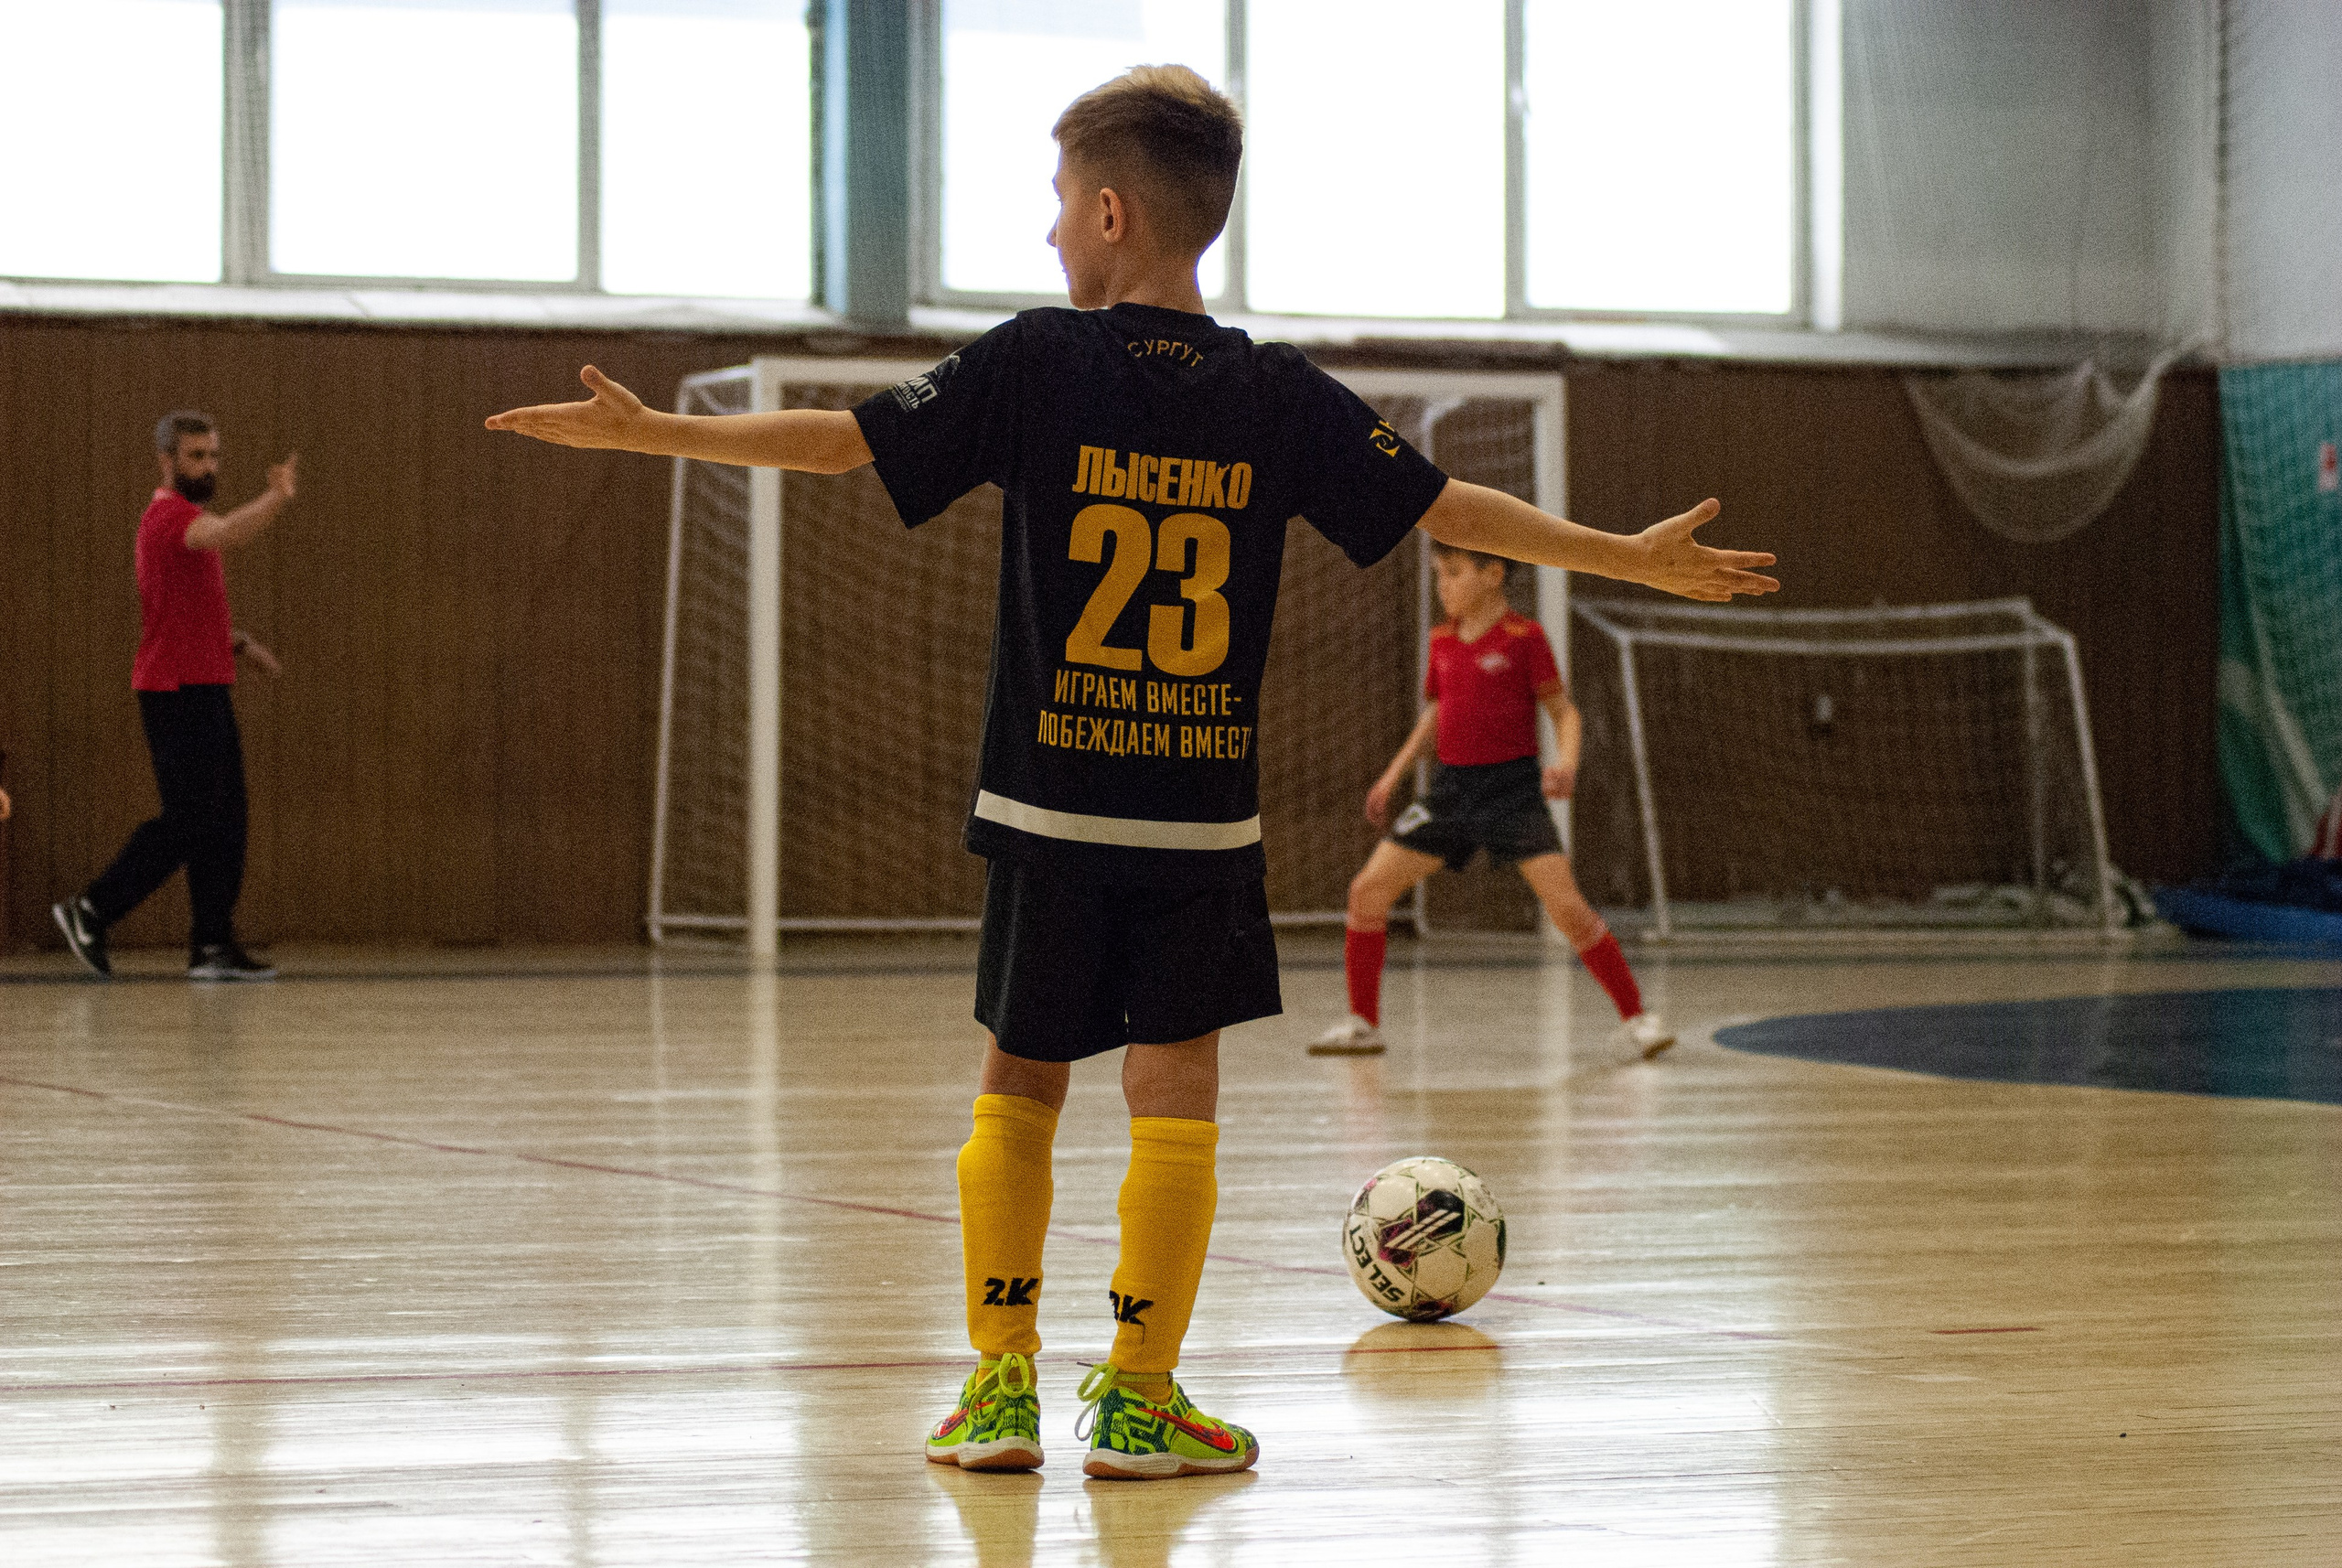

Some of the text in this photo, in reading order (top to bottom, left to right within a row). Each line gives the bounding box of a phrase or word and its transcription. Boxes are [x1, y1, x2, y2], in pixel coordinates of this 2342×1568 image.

[1127, 339, 1204, 368] СУРГУТ
[1072, 446, 1252, 510] ЛЫСЕНКО
[1066, 504, 1231, 676] 23
[1054, 669, 1242, 716] ИГРАЕМ ВМЕСТЕ-
[1037, 710, 1252, 759] ПОБЕЖДАЕМ ВМЕСТ
[1349, 1225, 1405, 1302] SELECT
